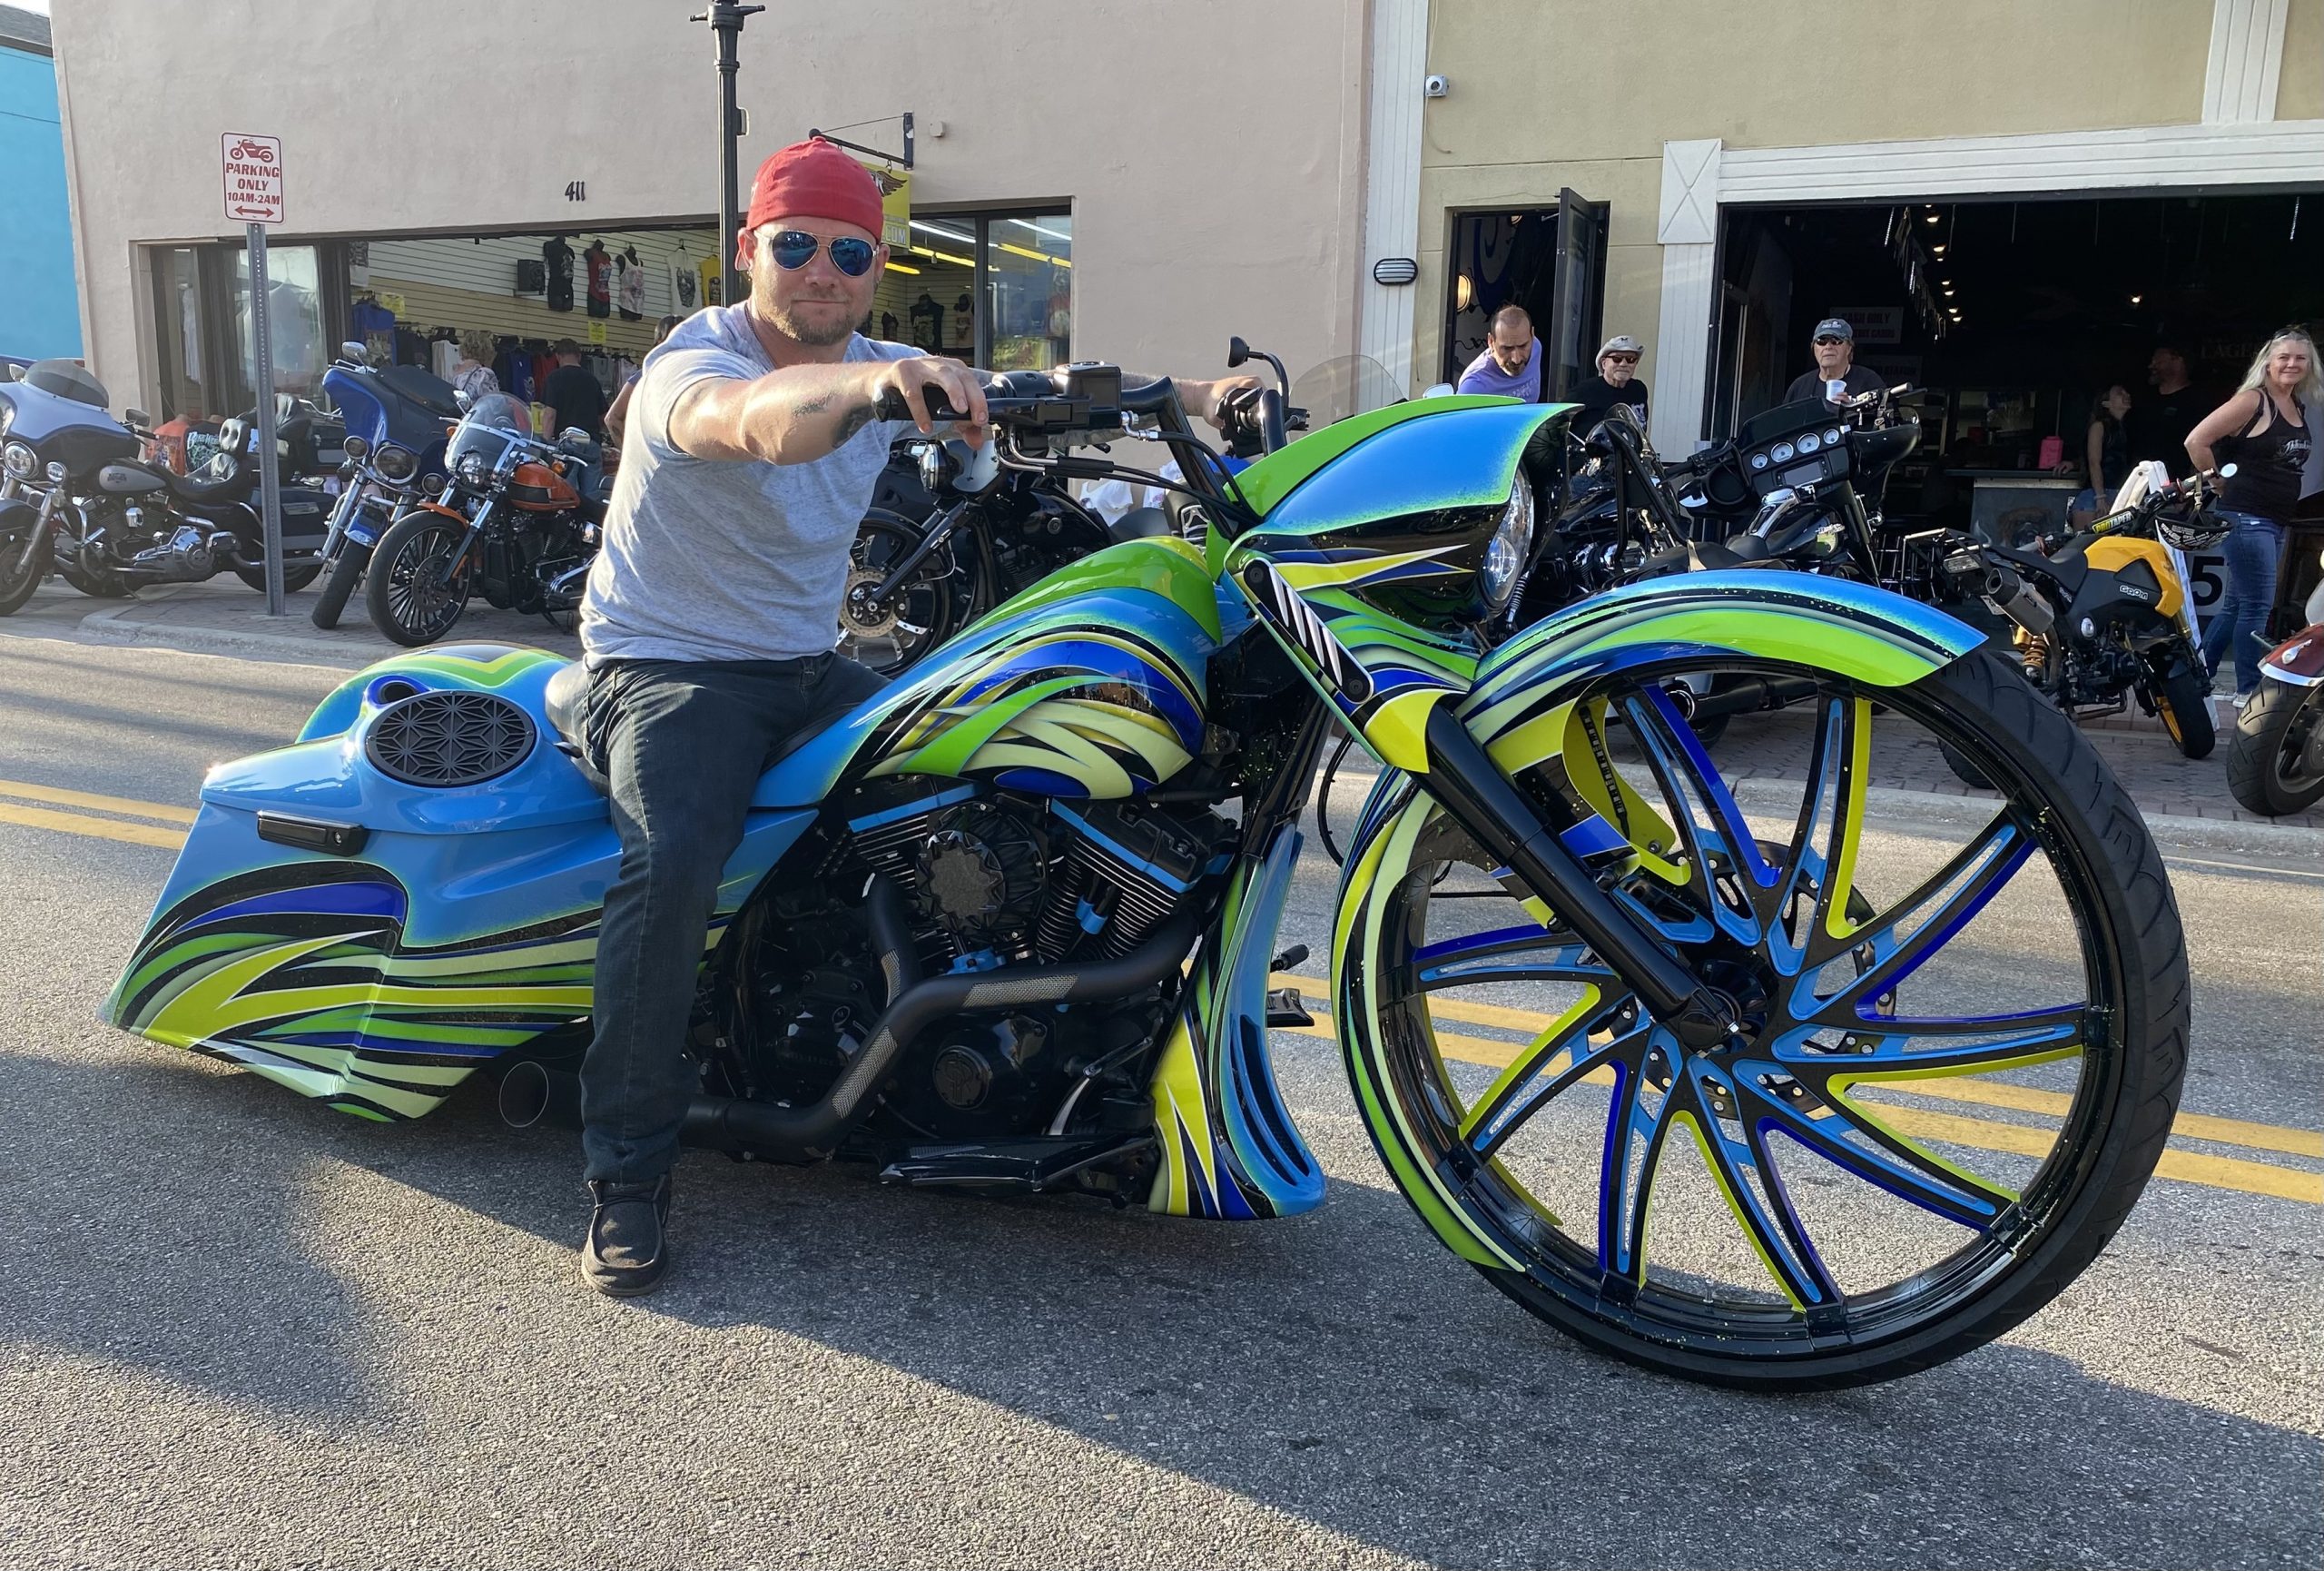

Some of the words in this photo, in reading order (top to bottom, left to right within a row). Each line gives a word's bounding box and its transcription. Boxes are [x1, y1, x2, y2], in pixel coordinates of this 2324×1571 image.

[225, 163, 280, 178] PARKING
[237, 178, 269, 191] ONLY
[564, 181, 586, 202] 411
[227, 192, 281, 205] 10AM-2AM
[882, 225, 906, 245] .COM
[2190, 556, 2225, 607] 5
[2119, 584, 2149, 600] GROM
